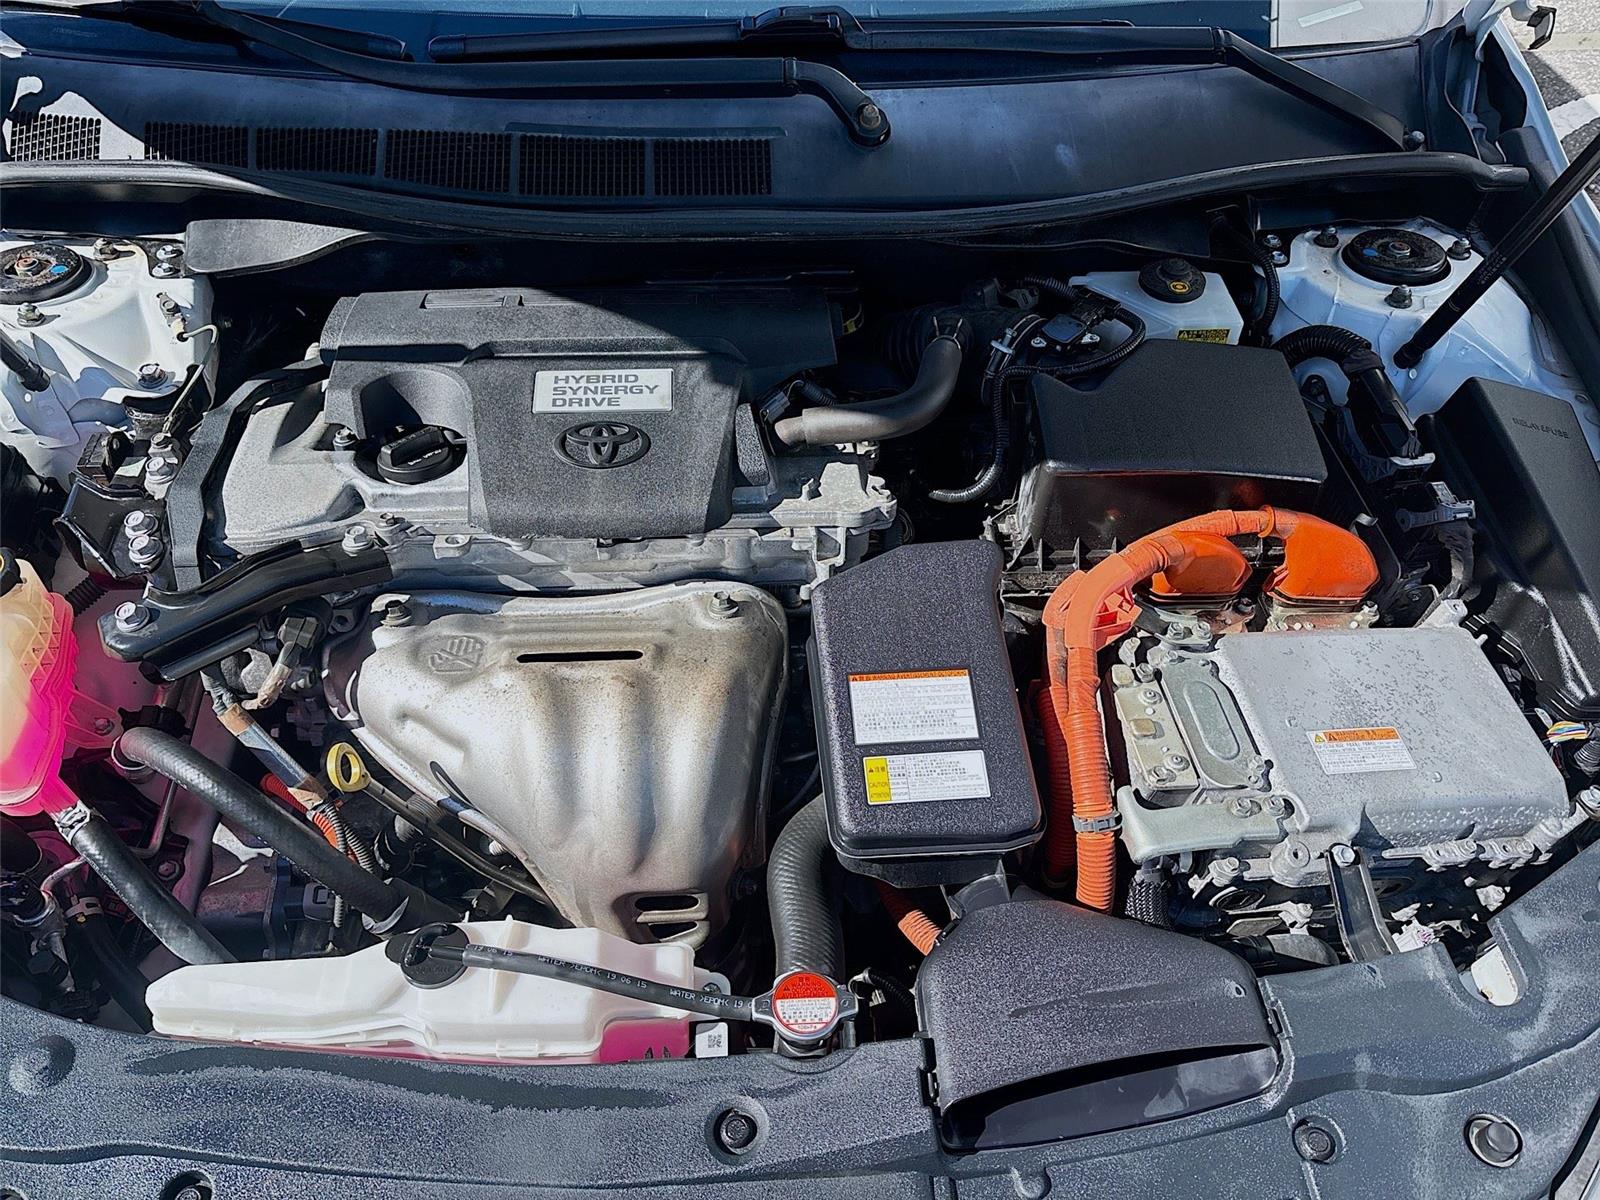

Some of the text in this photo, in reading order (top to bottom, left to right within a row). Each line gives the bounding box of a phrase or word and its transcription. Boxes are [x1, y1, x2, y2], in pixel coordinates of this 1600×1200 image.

[553, 374, 639, 384] HYBRID
[552, 385, 659, 396] SYNERGY
[551, 397, 621, 407] DRIVE
[669, 988, 696, 1000] WATER
[733, 1000, 743, 1008] 19
